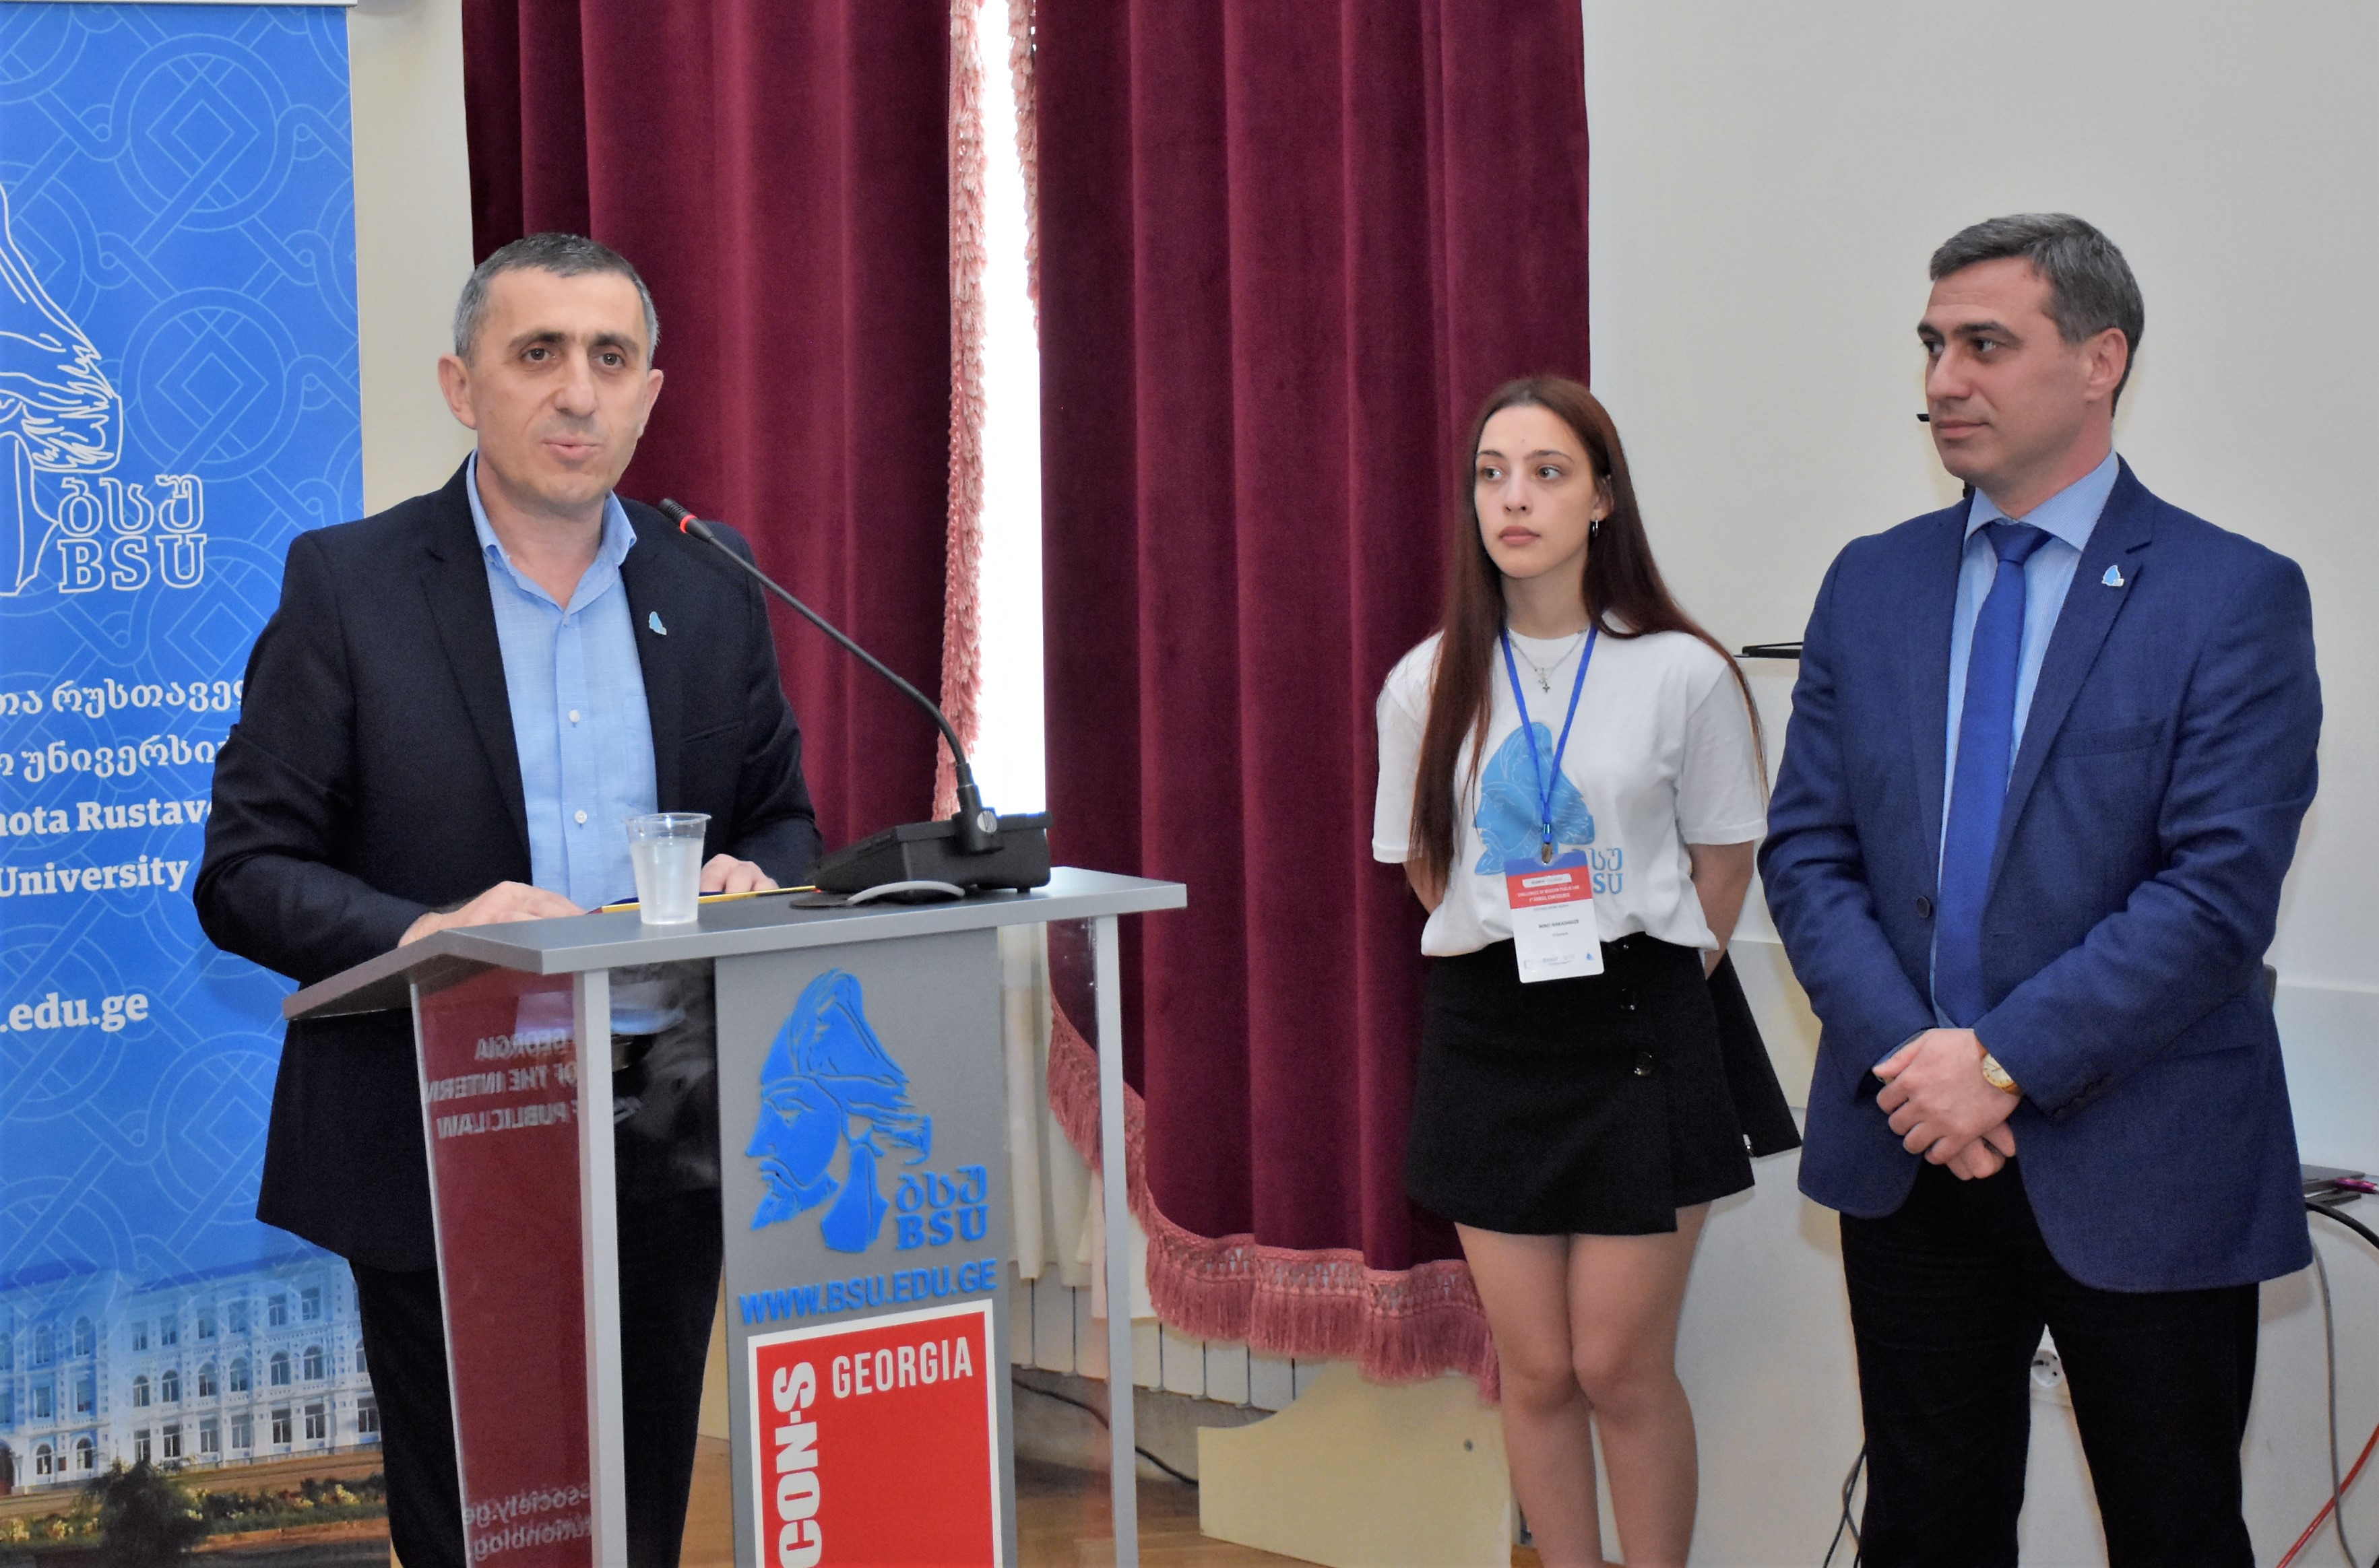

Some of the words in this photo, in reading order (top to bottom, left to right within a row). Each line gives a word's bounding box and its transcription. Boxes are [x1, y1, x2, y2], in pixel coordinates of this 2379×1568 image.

[57, 533, 207, 593] BSU
[21, 733, 228, 782] უნივერსი
[76, 797, 212, 832] Rustav
[0, 854, 189, 898] University
[0, 991, 148, 1032] .edu.ge
[896, 1204, 988, 1251] BSU
[739, 1258, 998, 1326] WWW.BSU.EDU.GE
[831, 1336, 974, 1400] GEORGIA
